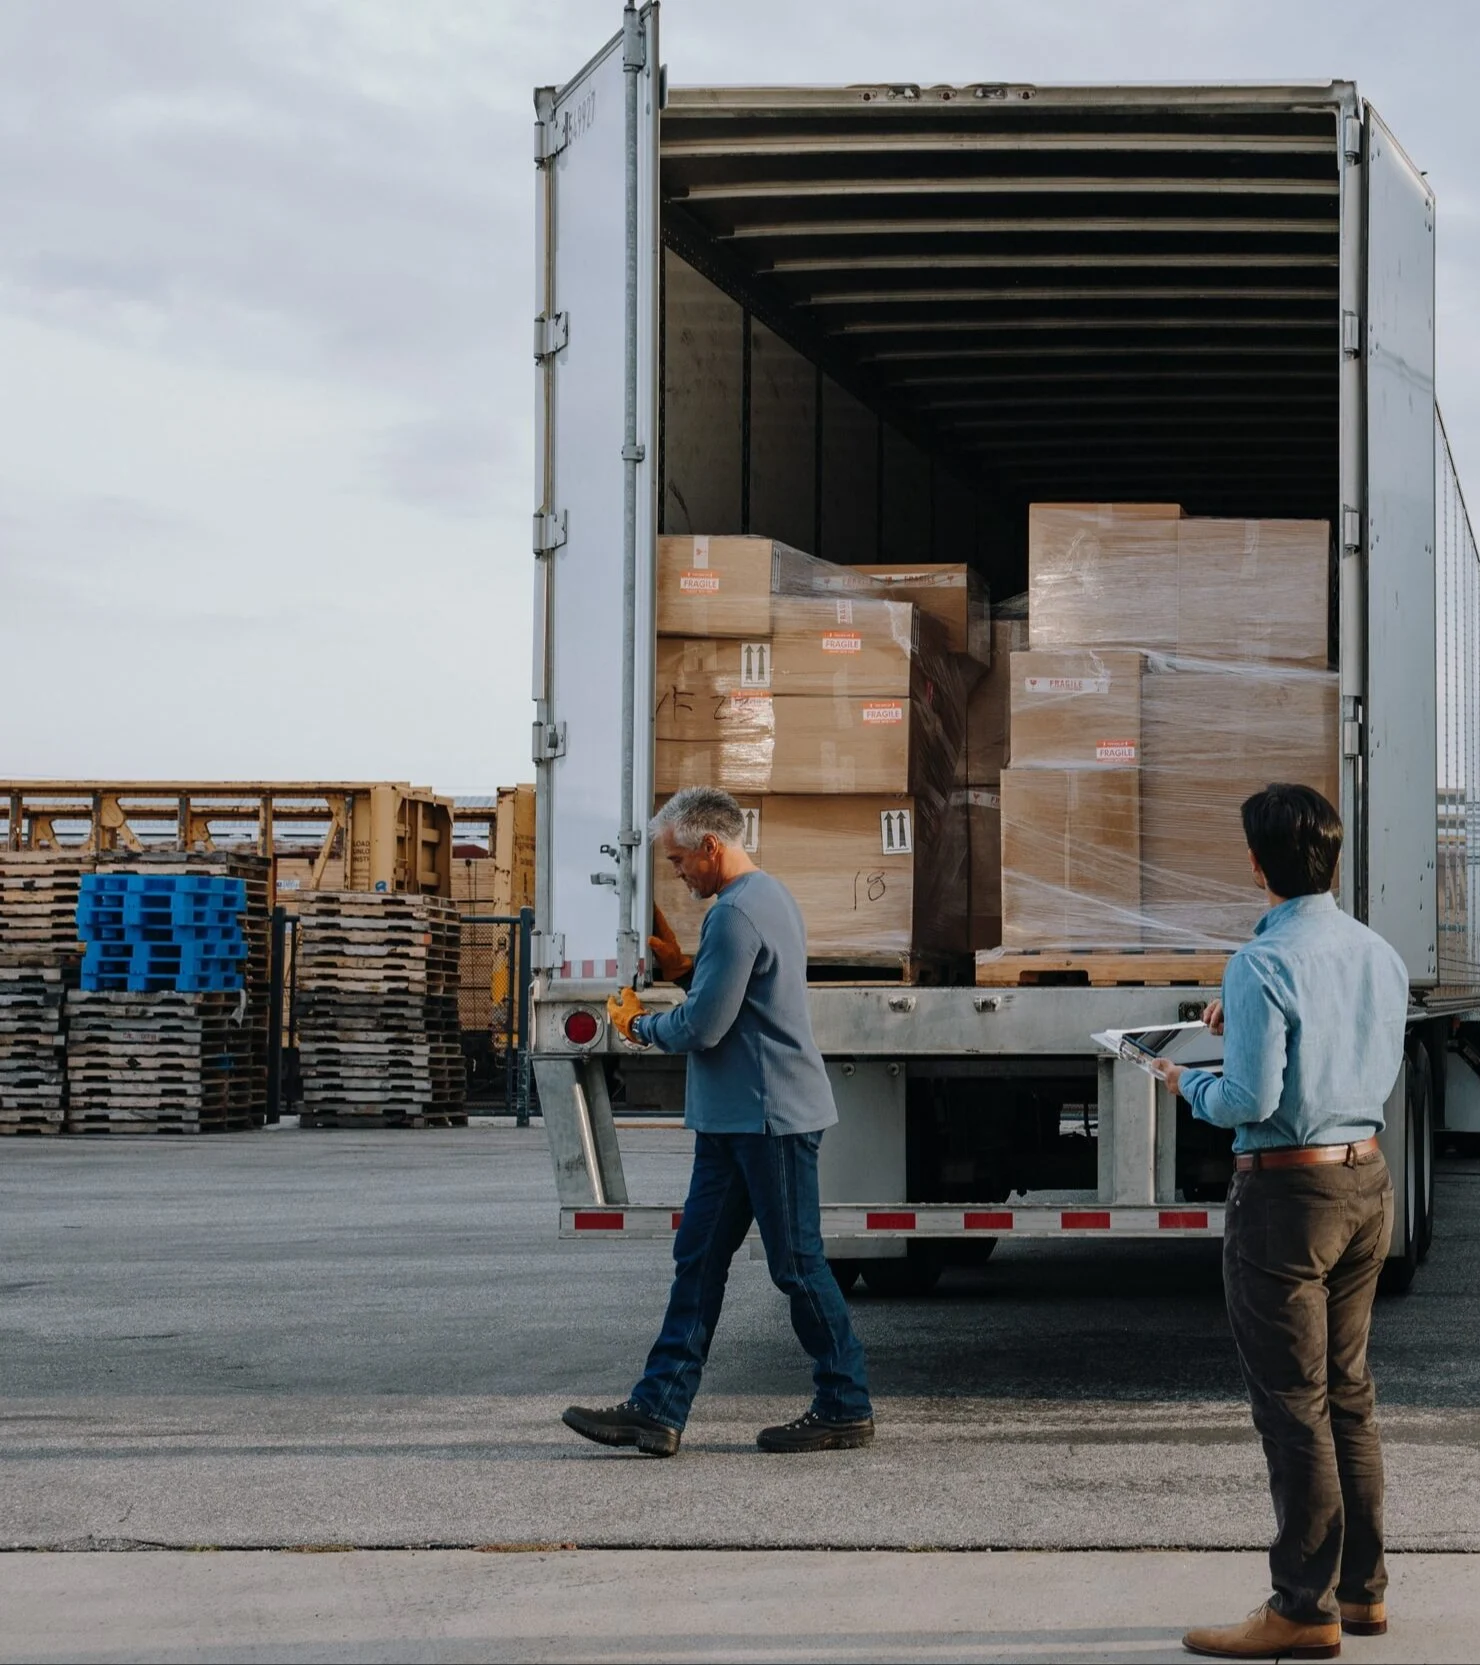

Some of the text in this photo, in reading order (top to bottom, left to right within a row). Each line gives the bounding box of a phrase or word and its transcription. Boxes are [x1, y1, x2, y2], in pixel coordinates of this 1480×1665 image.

[684, 579, 717, 588] FRAGILE
[826, 639, 859, 648] FRAGILE
[1049, 680, 1083, 690] FRAGILE
[866, 710, 900, 719] FRAGILE
[1100, 748, 1133, 757] FRAGILE
[853, 870, 886, 910] 18
